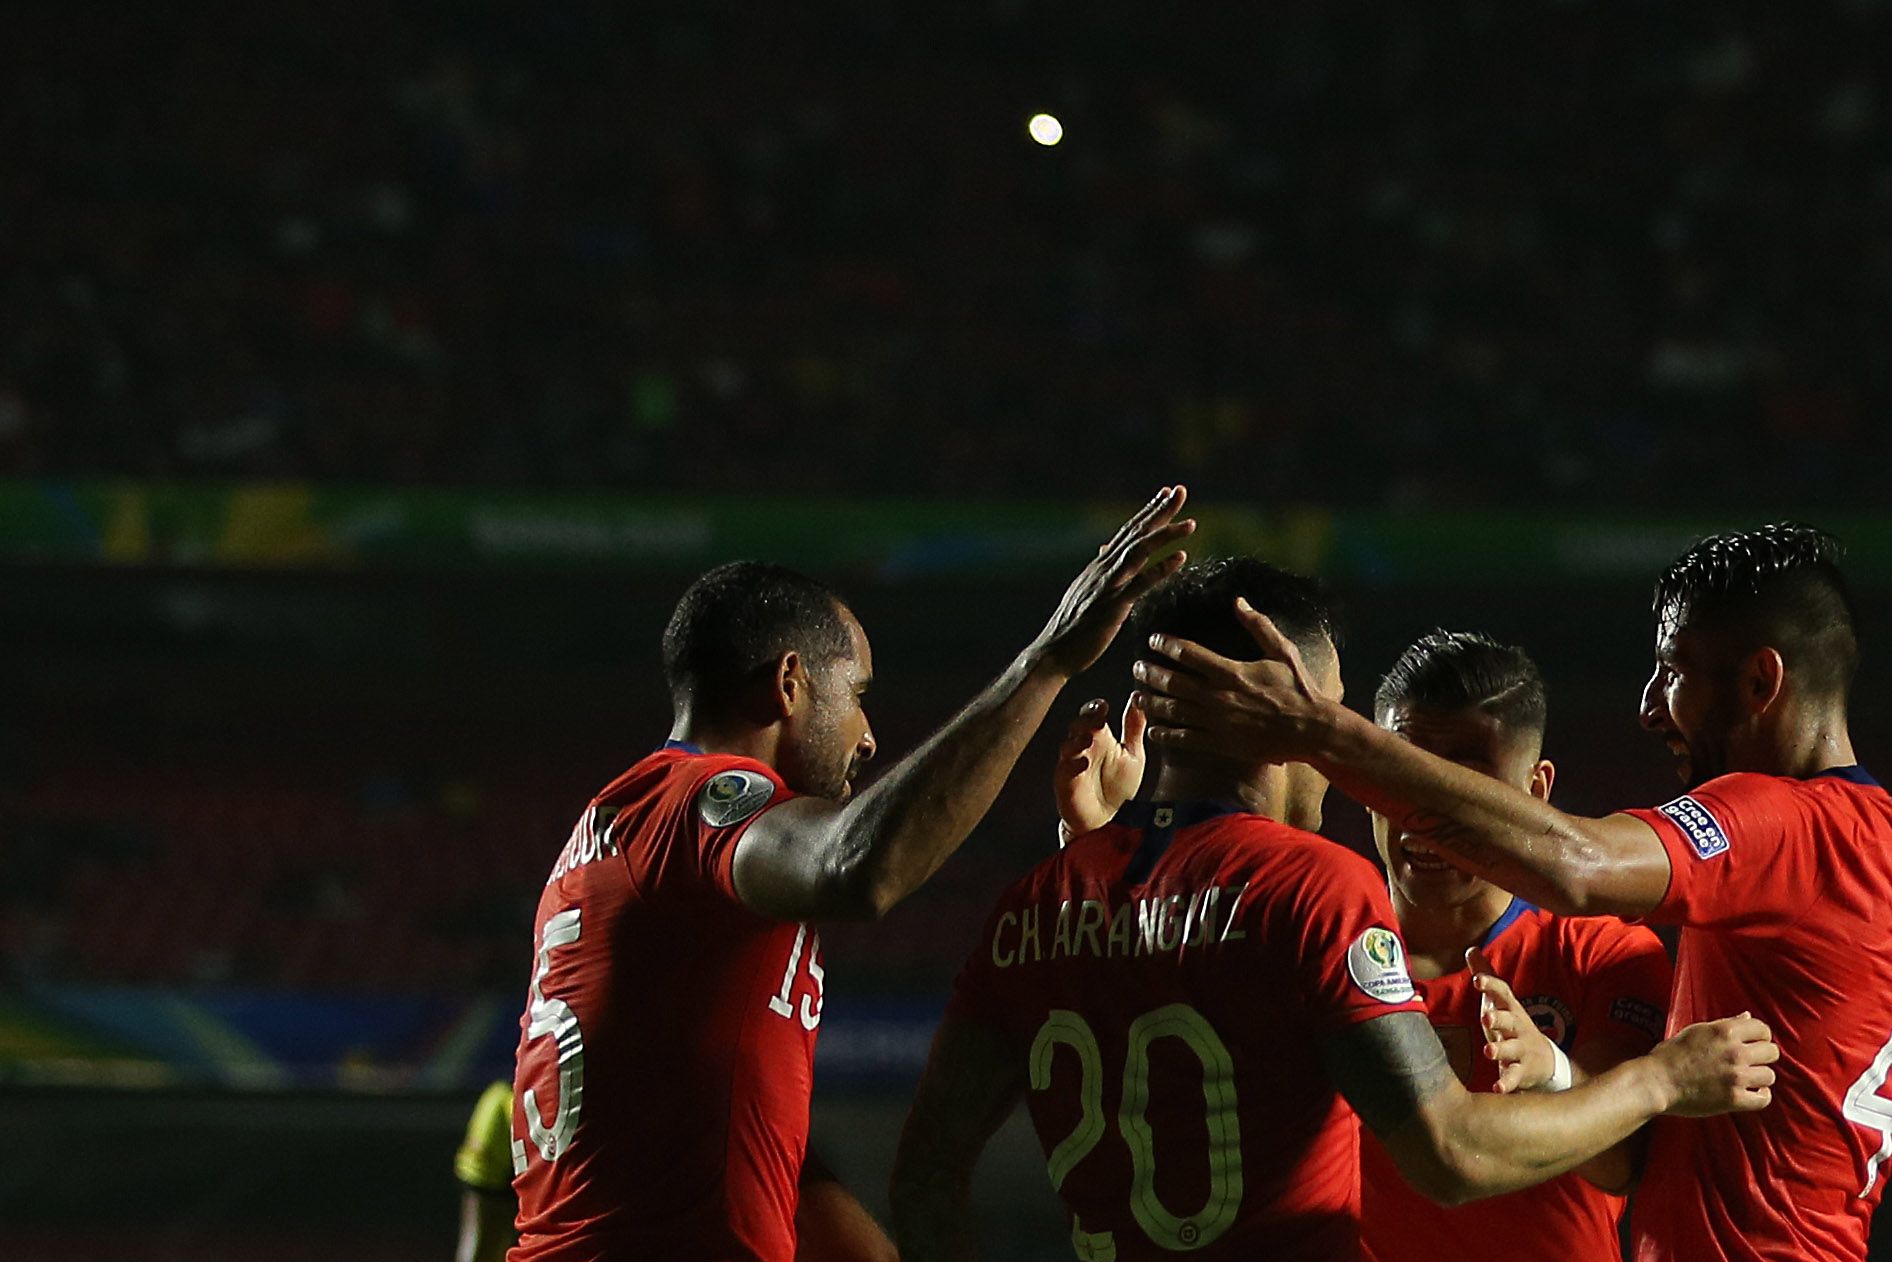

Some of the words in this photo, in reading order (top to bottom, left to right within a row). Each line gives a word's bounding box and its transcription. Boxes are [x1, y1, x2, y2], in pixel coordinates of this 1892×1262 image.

[1665, 806, 1709, 848] grande
[1679, 800, 1708, 826] Cree
[1706, 827, 1721, 847] en
